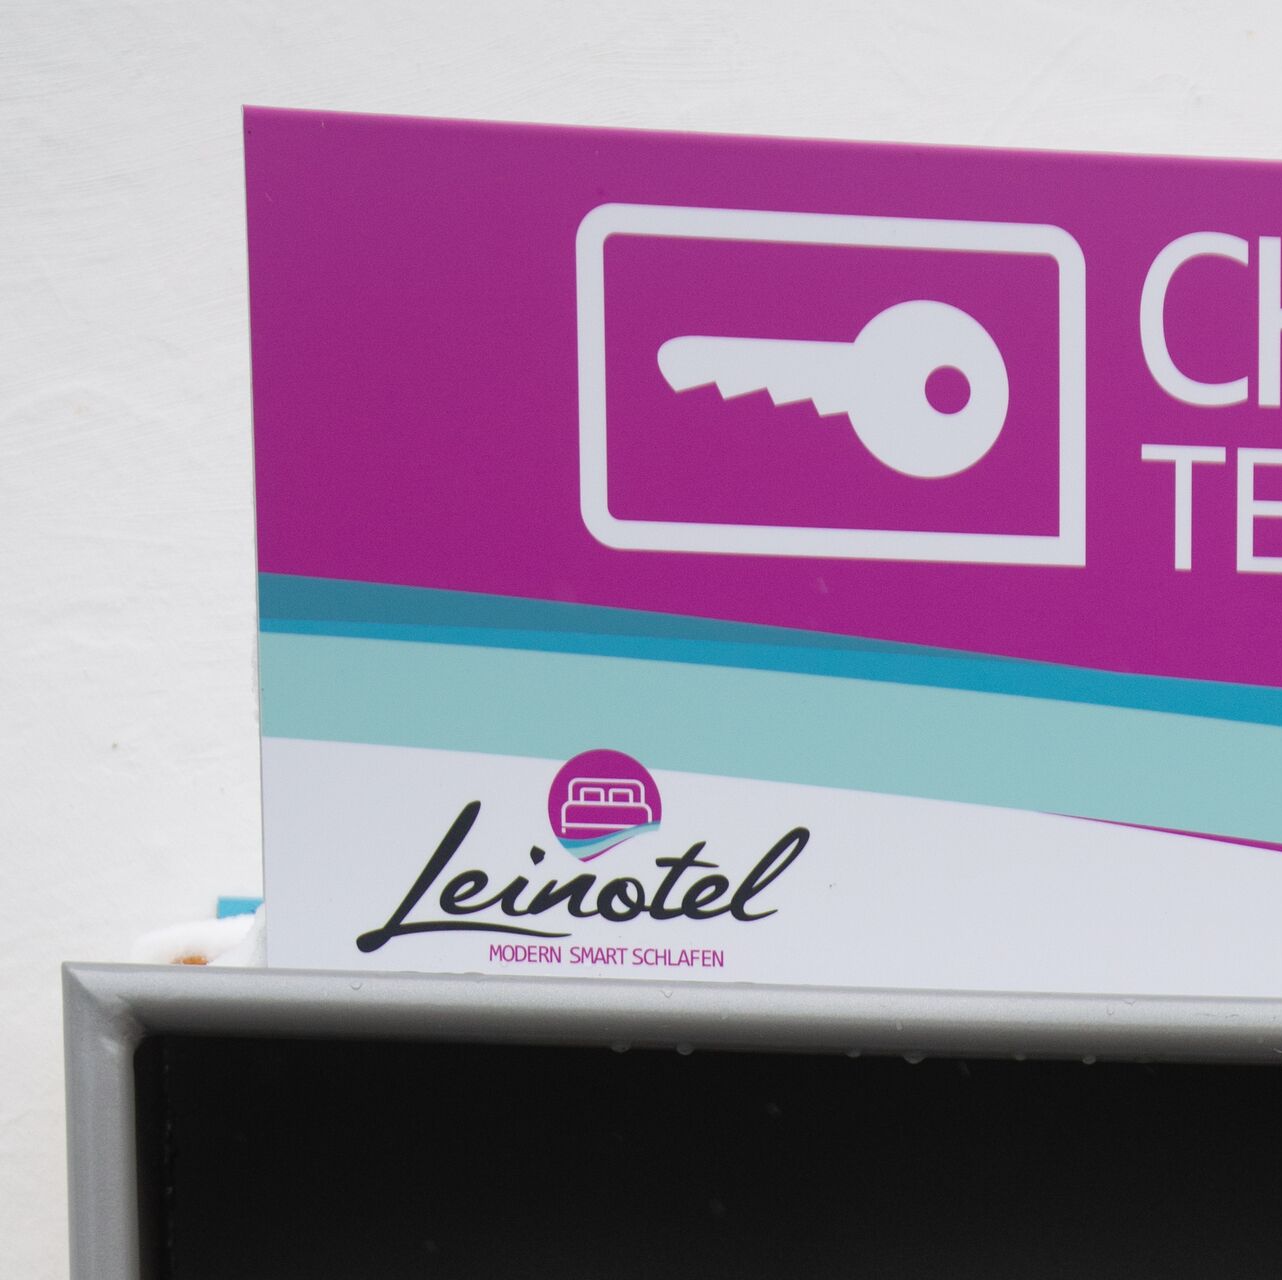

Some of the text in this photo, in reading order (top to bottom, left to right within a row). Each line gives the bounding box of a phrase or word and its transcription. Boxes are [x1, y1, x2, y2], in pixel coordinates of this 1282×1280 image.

[356, 800, 811, 954] Leinotel
[489, 944, 724, 968] MODERN SMART SCHLAFEN
